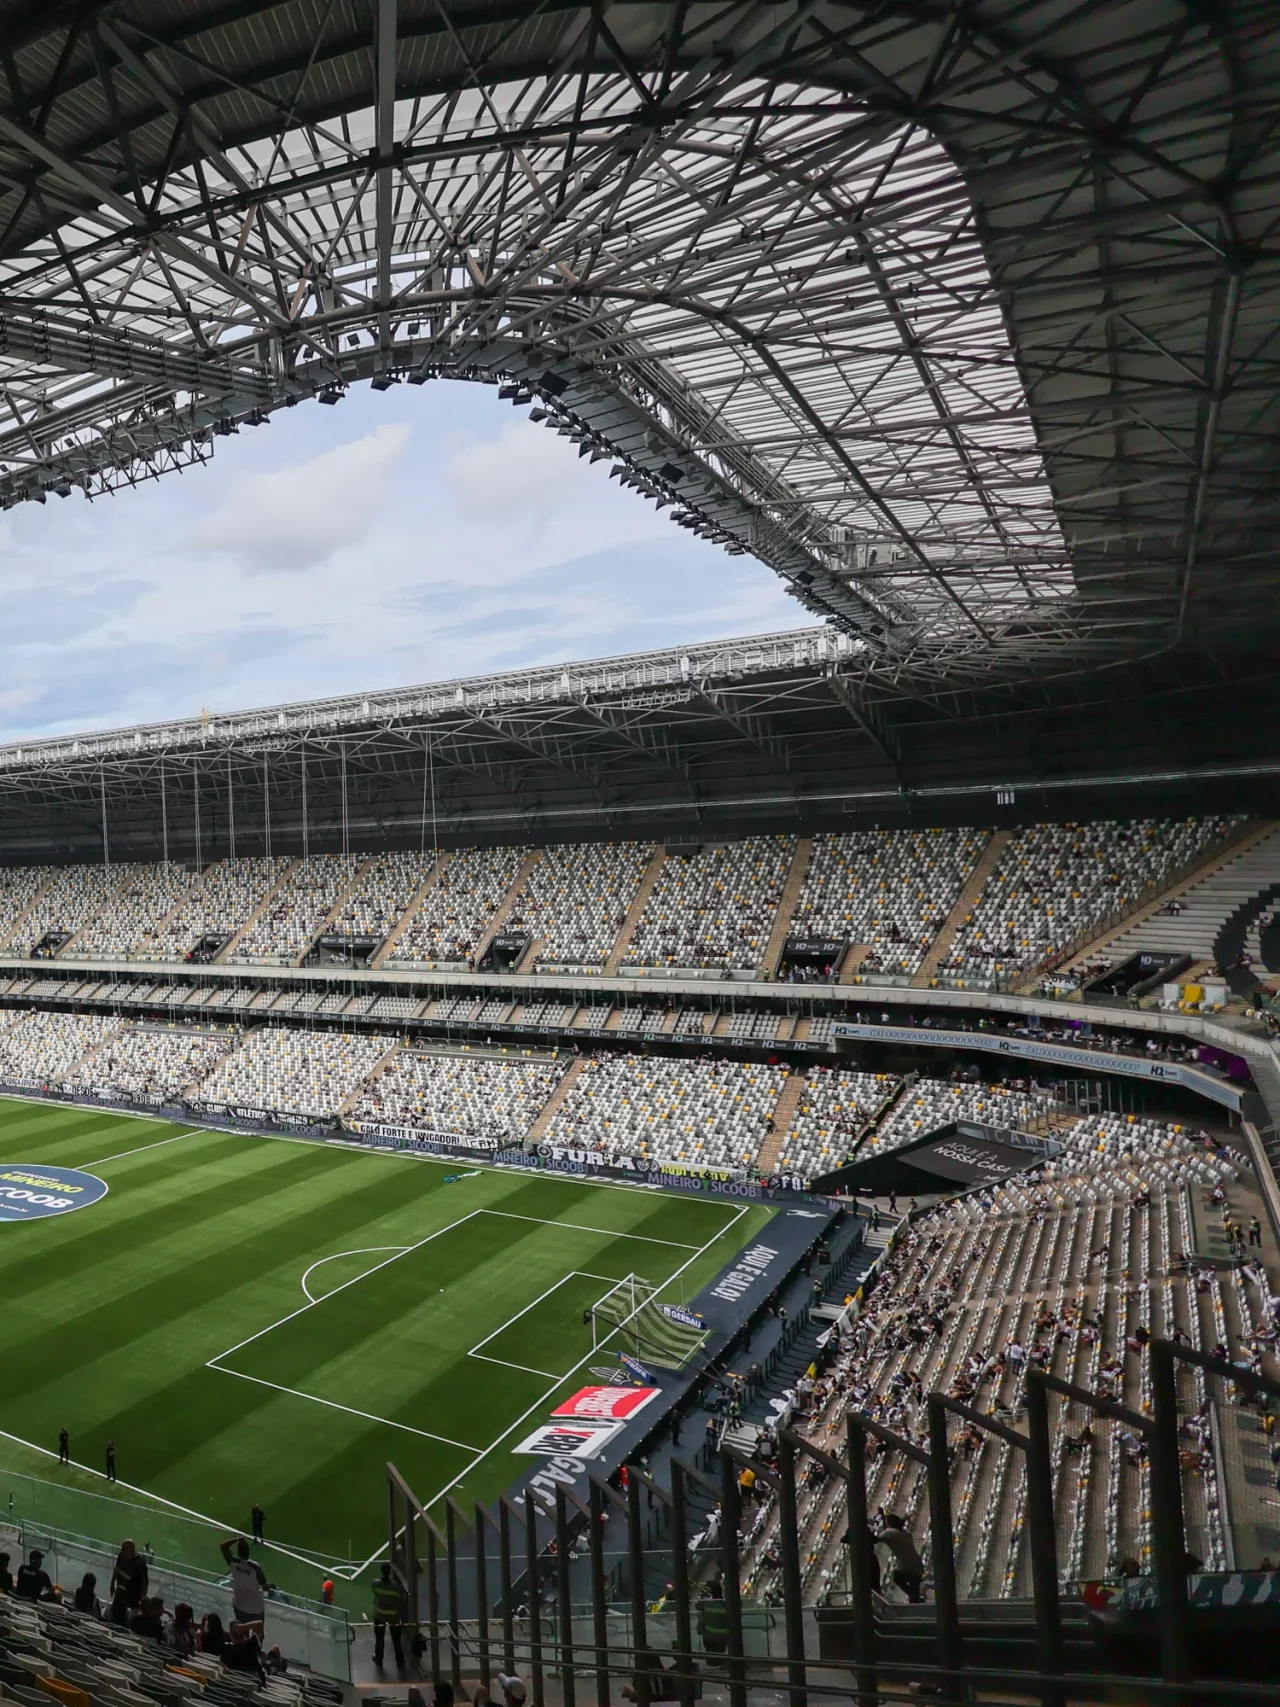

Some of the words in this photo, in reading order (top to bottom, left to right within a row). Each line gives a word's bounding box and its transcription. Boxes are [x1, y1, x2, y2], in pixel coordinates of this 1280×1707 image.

[201, 1113, 229, 1124] MINEIRO
[234, 1117, 257, 1128] SICOOB
[289, 1123, 317, 1136] SICOOB
[361, 1124, 380, 1135] GALO
[382, 1127, 406, 1139] FORTE
[408, 1131, 413, 1139] E
[362, 1135, 401, 1148] MINEIRO
[408, 1142, 440, 1153] SICOOB
[493, 1151, 538, 1167] MINEIRO
[546, 1158, 584, 1173] SICOOB
[933, 1146, 977, 1164] NOSSA
[976, 1161, 1011, 1173] CASA
[648, 1172, 701, 1189] MINEIRO
[711, 1180, 757, 1198] SICOOB
[742, 1244, 779, 1269] AQUI
[735, 1264, 768, 1276] É
[710, 1271, 755, 1302] GALO!
[671, 1310, 701, 1328] GERDAU
